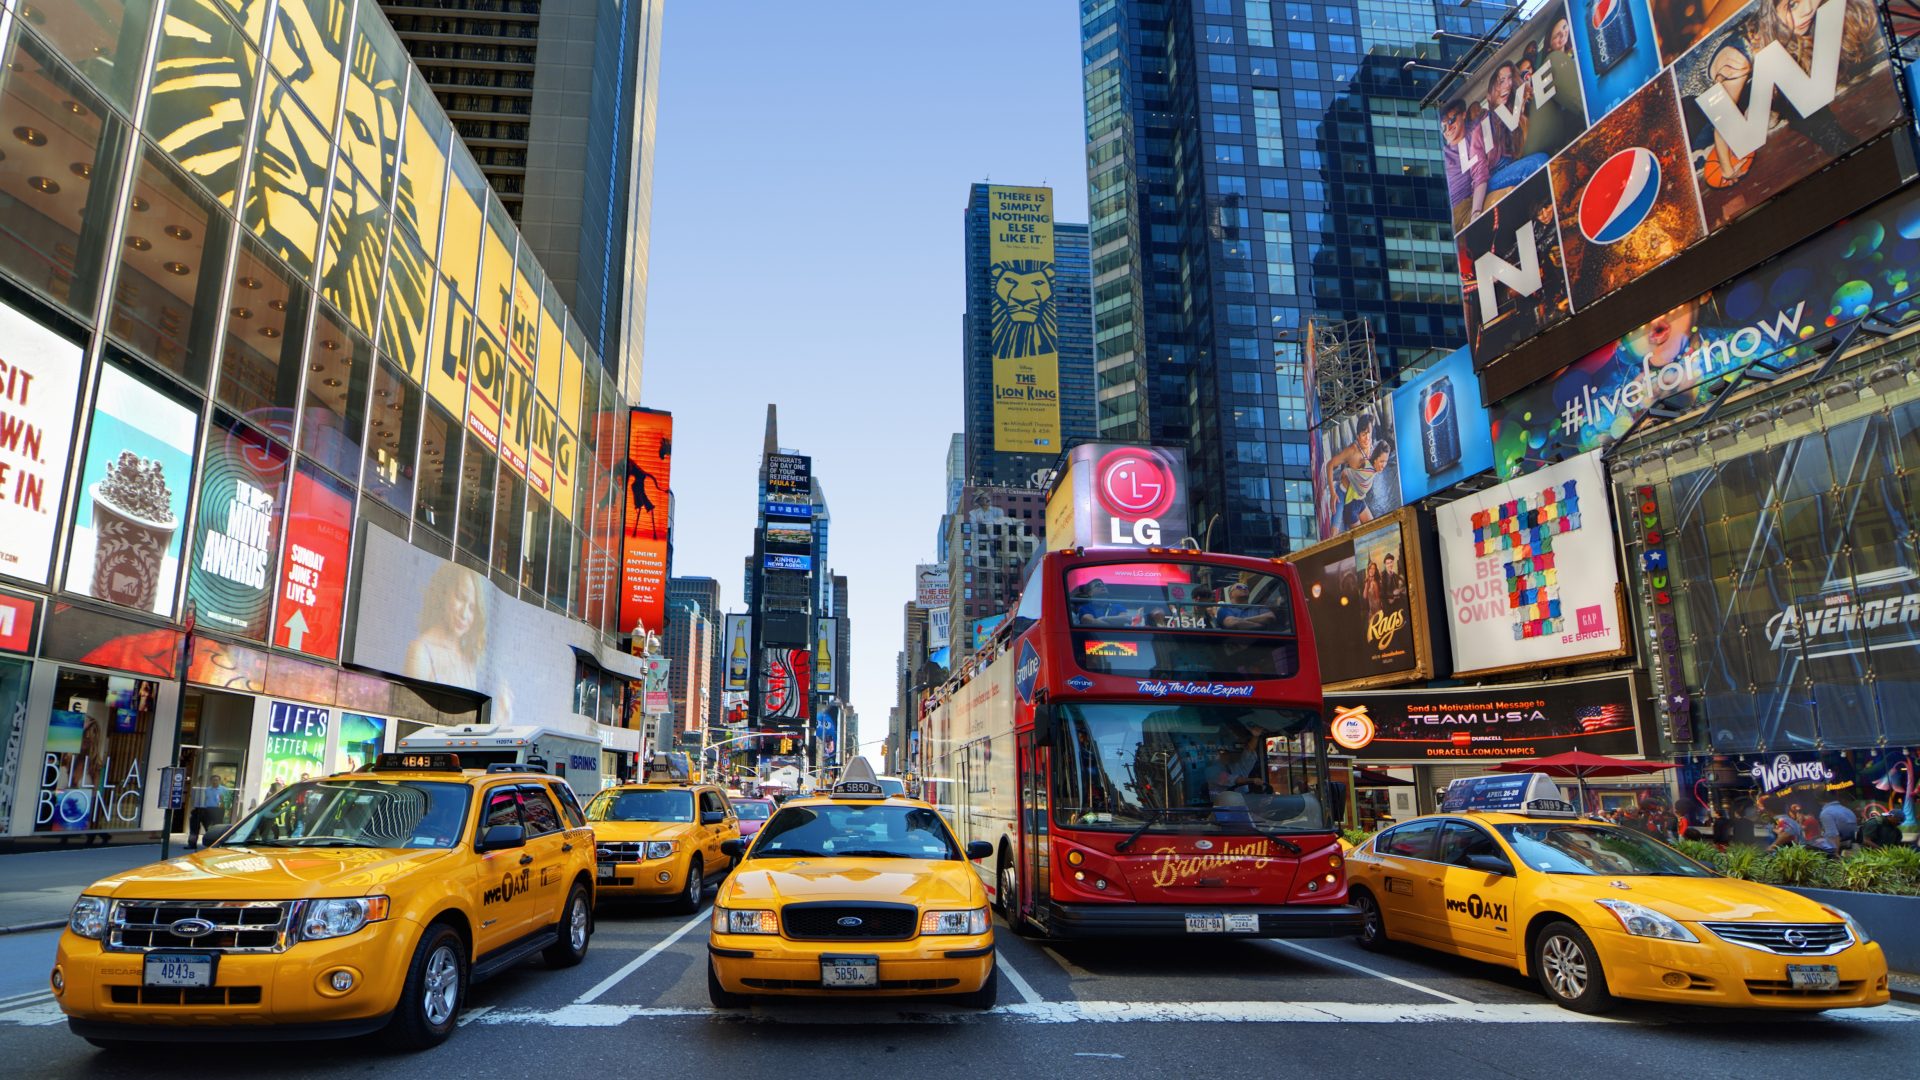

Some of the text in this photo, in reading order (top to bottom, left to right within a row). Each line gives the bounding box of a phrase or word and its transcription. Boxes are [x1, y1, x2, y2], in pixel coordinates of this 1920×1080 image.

[1460, 60, 1556, 174] LIVE
[1000, 202, 1041, 212] SIMPLY
[1034, 194, 1045, 202] IS
[992, 212, 1050, 223] NOTHING
[999, 233, 1026, 243] LIKE
[1008, 223, 1035, 233] ELSE
[499, 283, 536, 362] THE
[442, 276, 570, 476] LION KING
[1016, 373, 1037, 383] THE
[1561, 300, 1806, 436] #livefornow
[996, 385, 1057, 401] LION KING
[470, 414, 498, 446] ENTRANCE
[502, 445, 512, 459] ON
[1426, 430, 1439, 464] pepsi
[769, 479, 790, 487] PAULA
[770, 474, 808, 482] RETIREMENT
[14, 469, 47, 514] IN.
[226, 498, 272, 552] MOVIE
[1110, 517, 1162, 545] LG
[200, 529, 269, 590] AWARDS
[290, 543, 326, 573] SUNDAY
[626, 558, 663, 567] ANYTHING
[774, 556, 802, 564] XINHUA
[288, 563, 319, 589] JUNE 3
[626, 567, 663, 576] BROADWAY
[1475, 562, 1500, 580] BE
[285, 581, 306, 604] LIVE
[1450, 579, 1504, 606] YOUR
[1825, 594, 1850, 605] MARVEL
[1165, 615, 1206, 629] 71514
[1457, 600, 1506, 624] OWN
[1582, 612, 1598, 626] GAP
[1367, 608, 1405, 650] Rags
[1561, 628, 1611, 644] BE BRIGHT
[1137, 680, 1254, 698] Truly, The Local Expert!
[1407, 704, 1430, 713] Send
[1438, 701, 1494, 712] Motivational
[1495, 701, 1534, 711] Message
[1534, 700, 1545, 708] to
[269, 703, 328, 738] LIFE'S
[1408, 714, 1481, 725] TEAM
[266, 736, 308, 756] BETTER
[1426, 747, 1536, 757] DURACELL.COM/OLYMPICS
[41, 753, 141, 789] BILLA
[1751, 754, 1834, 792] WONKA
[846, 783, 869, 793] 5B50
[36, 788, 140, 824] BONG
[1539, 799, 1561, 810] 3N99
[1152, 839, 1274, 888] Broadway
[483, 868, 530, 907] NYC TAXI
[1446, 893, 1508, 923] NYC TAXI
